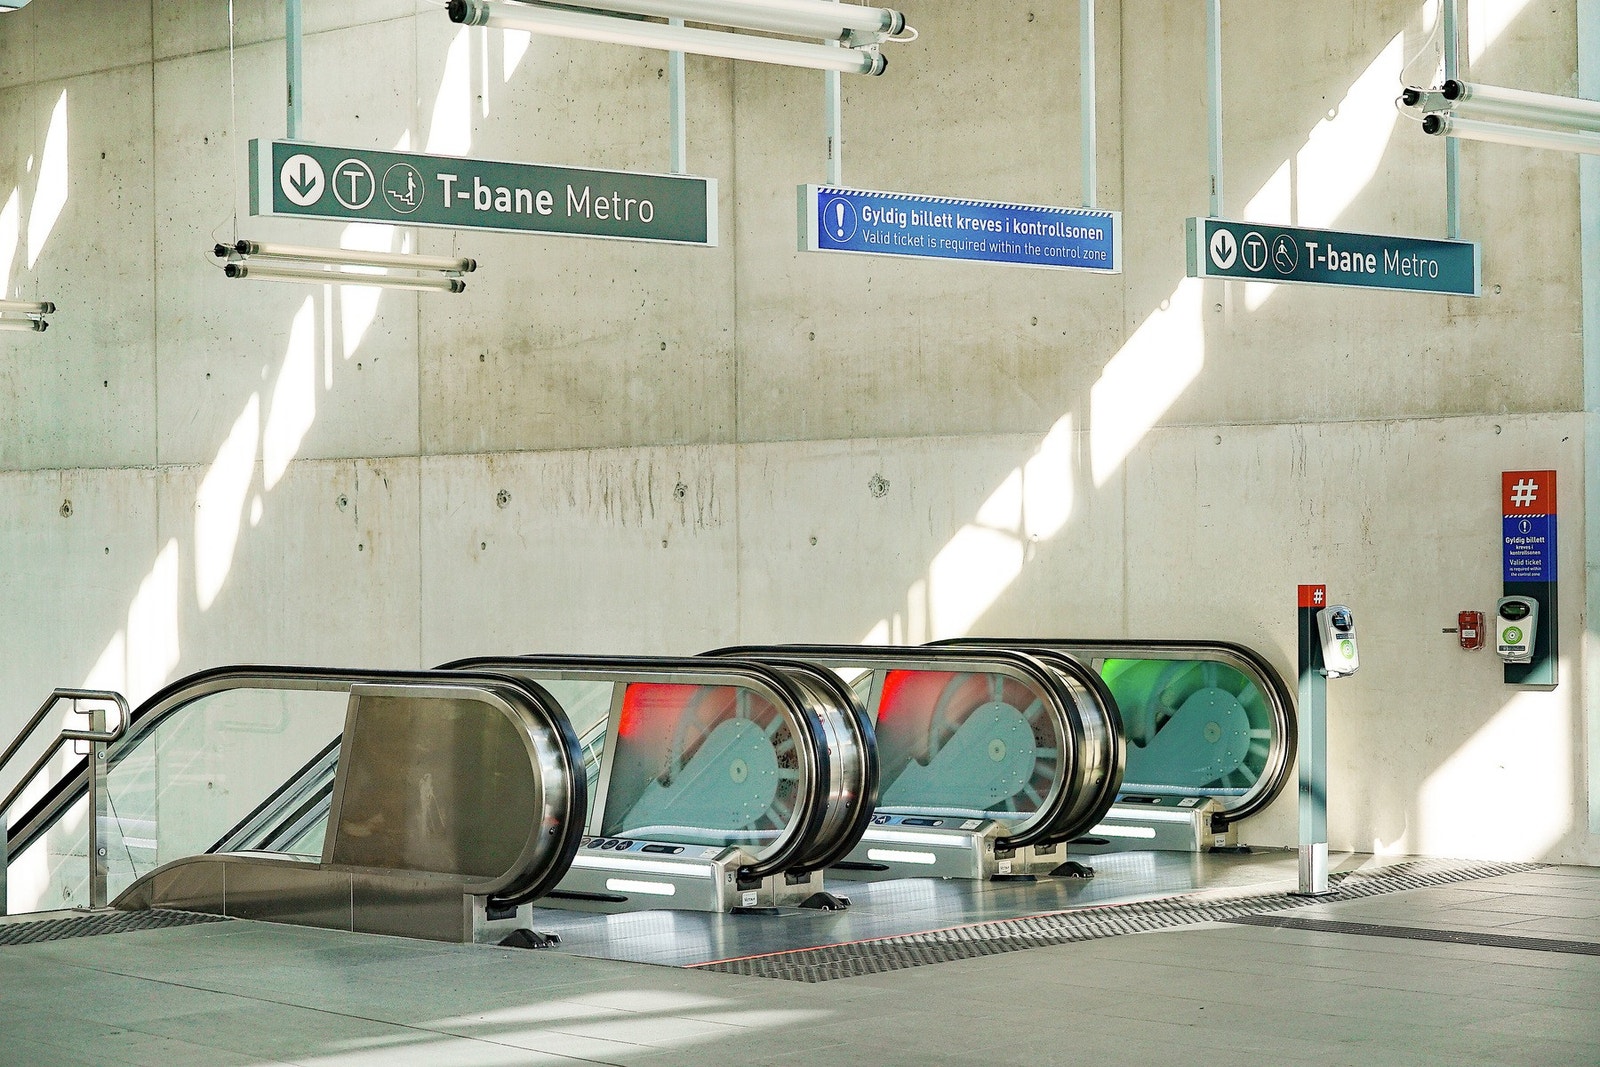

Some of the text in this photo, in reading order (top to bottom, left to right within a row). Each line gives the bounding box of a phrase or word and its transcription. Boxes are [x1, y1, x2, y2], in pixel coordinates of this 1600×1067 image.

[436, 173, 655, 223] T-bane Metro
[862, 205, 1104, 241] Gyldig billett kreves i kontrollsonen
[862, 229, 1107, 261] Valid ticket is required within the control zone
[1305, 242, 1439, 279] T-bane Metro
[1505, 536, 1545, 545] Gyldig billett
